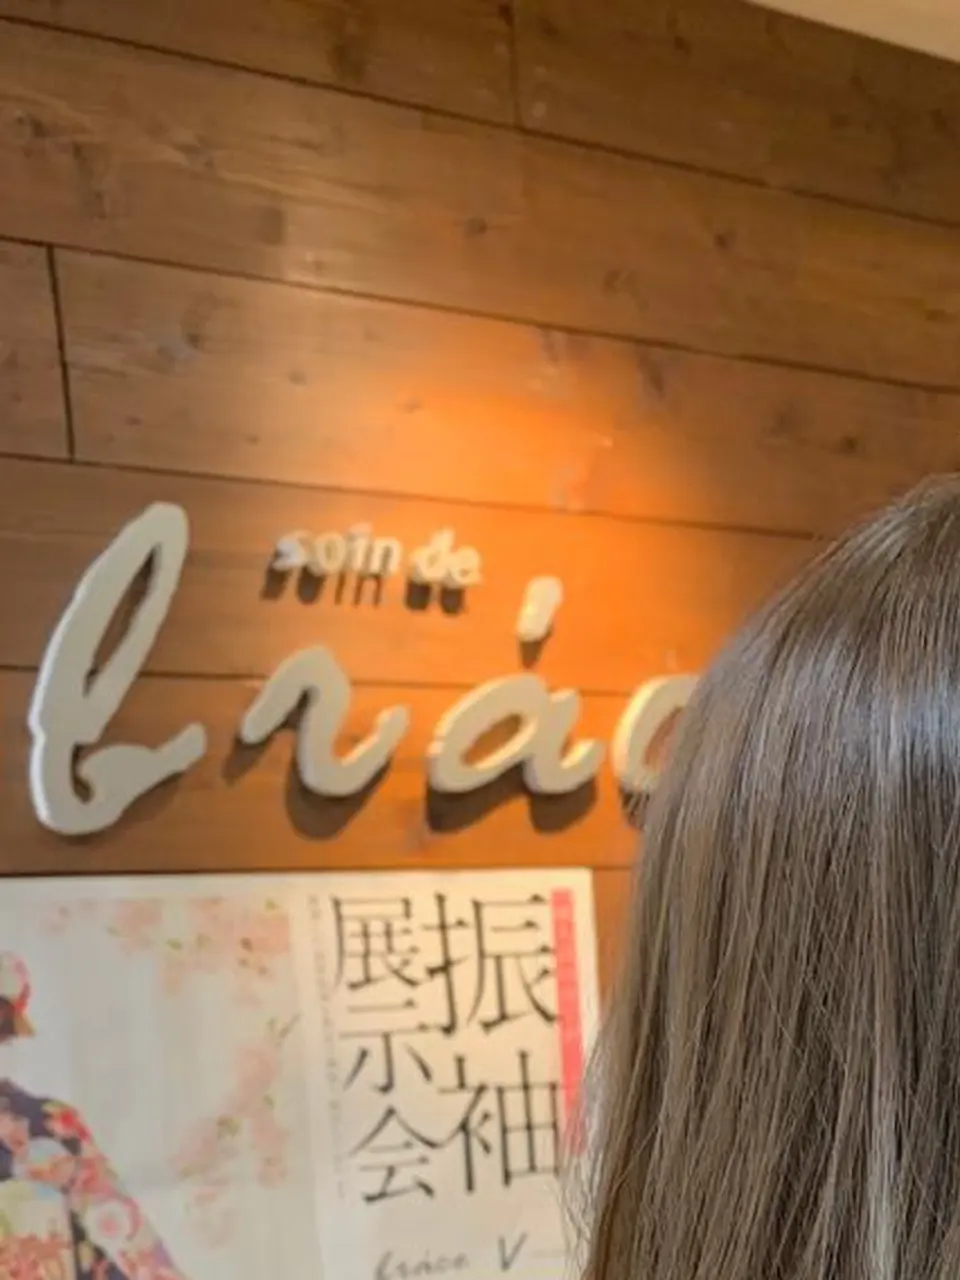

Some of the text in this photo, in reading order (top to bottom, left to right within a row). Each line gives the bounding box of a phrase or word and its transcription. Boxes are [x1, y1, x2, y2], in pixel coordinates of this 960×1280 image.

[272, 523, 482, 587] soin de
[331, 894, 444, 1204] 展示会
[420, 892, 564, 1197] 振袖
[498, 1231, 528, 1271] V
